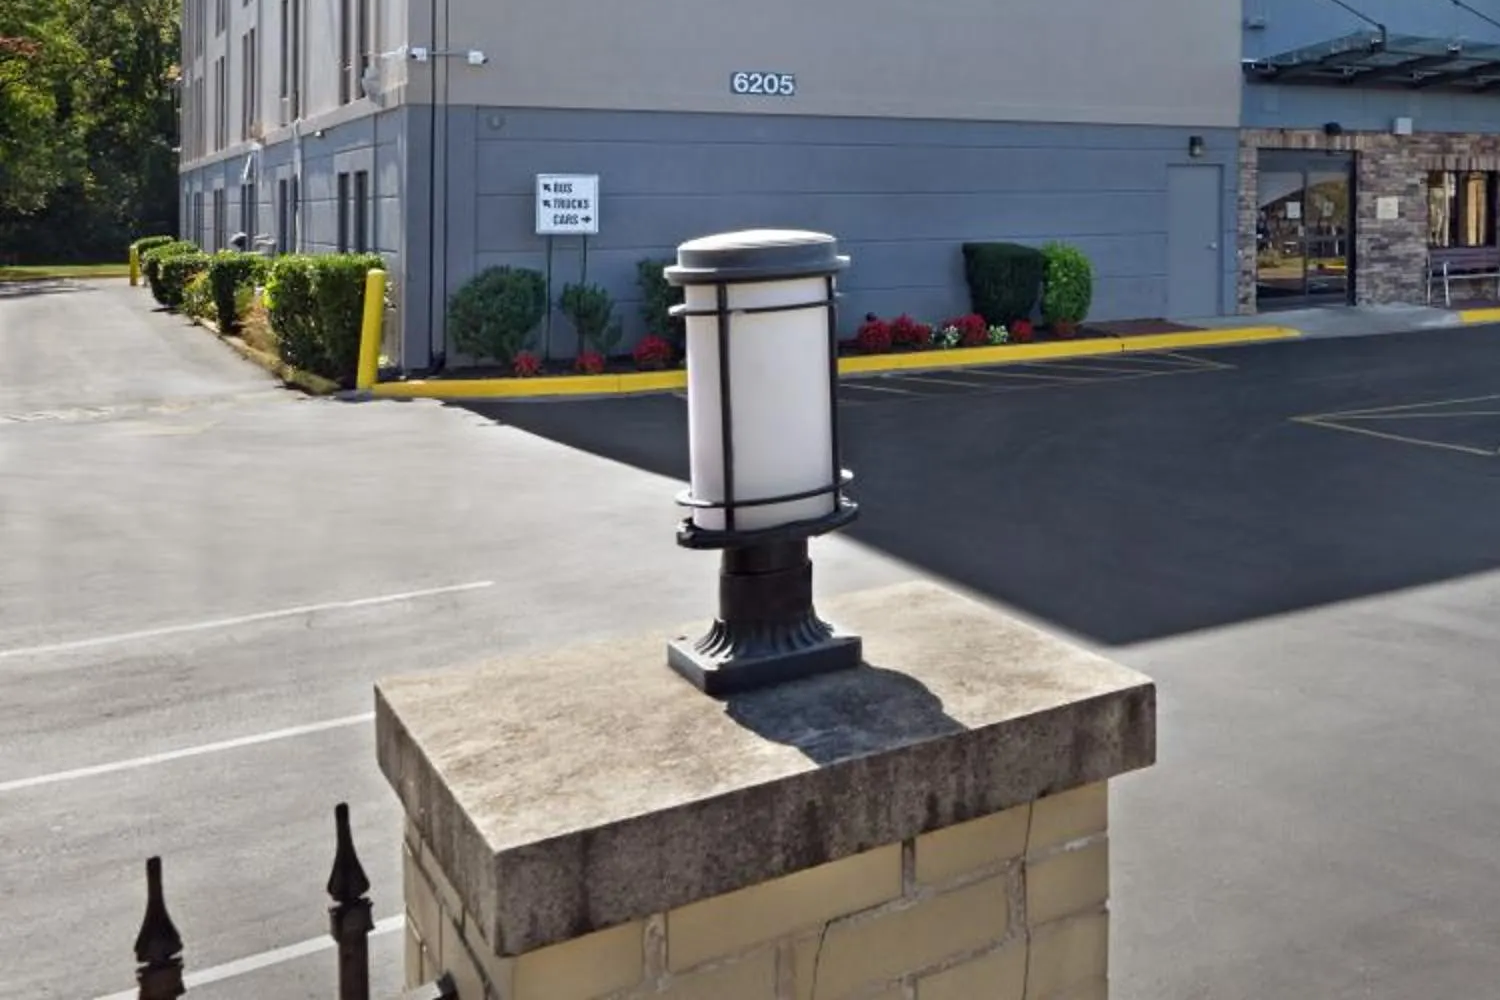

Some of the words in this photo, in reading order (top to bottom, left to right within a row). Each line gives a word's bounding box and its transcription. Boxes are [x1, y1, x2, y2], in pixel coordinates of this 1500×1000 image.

[733, 72, 794, 95] 6205
[553, 183, 573, 193] BUS
[553, 199, 590, 210] TRUCKS
[553, 214, 579, 225] CARS
